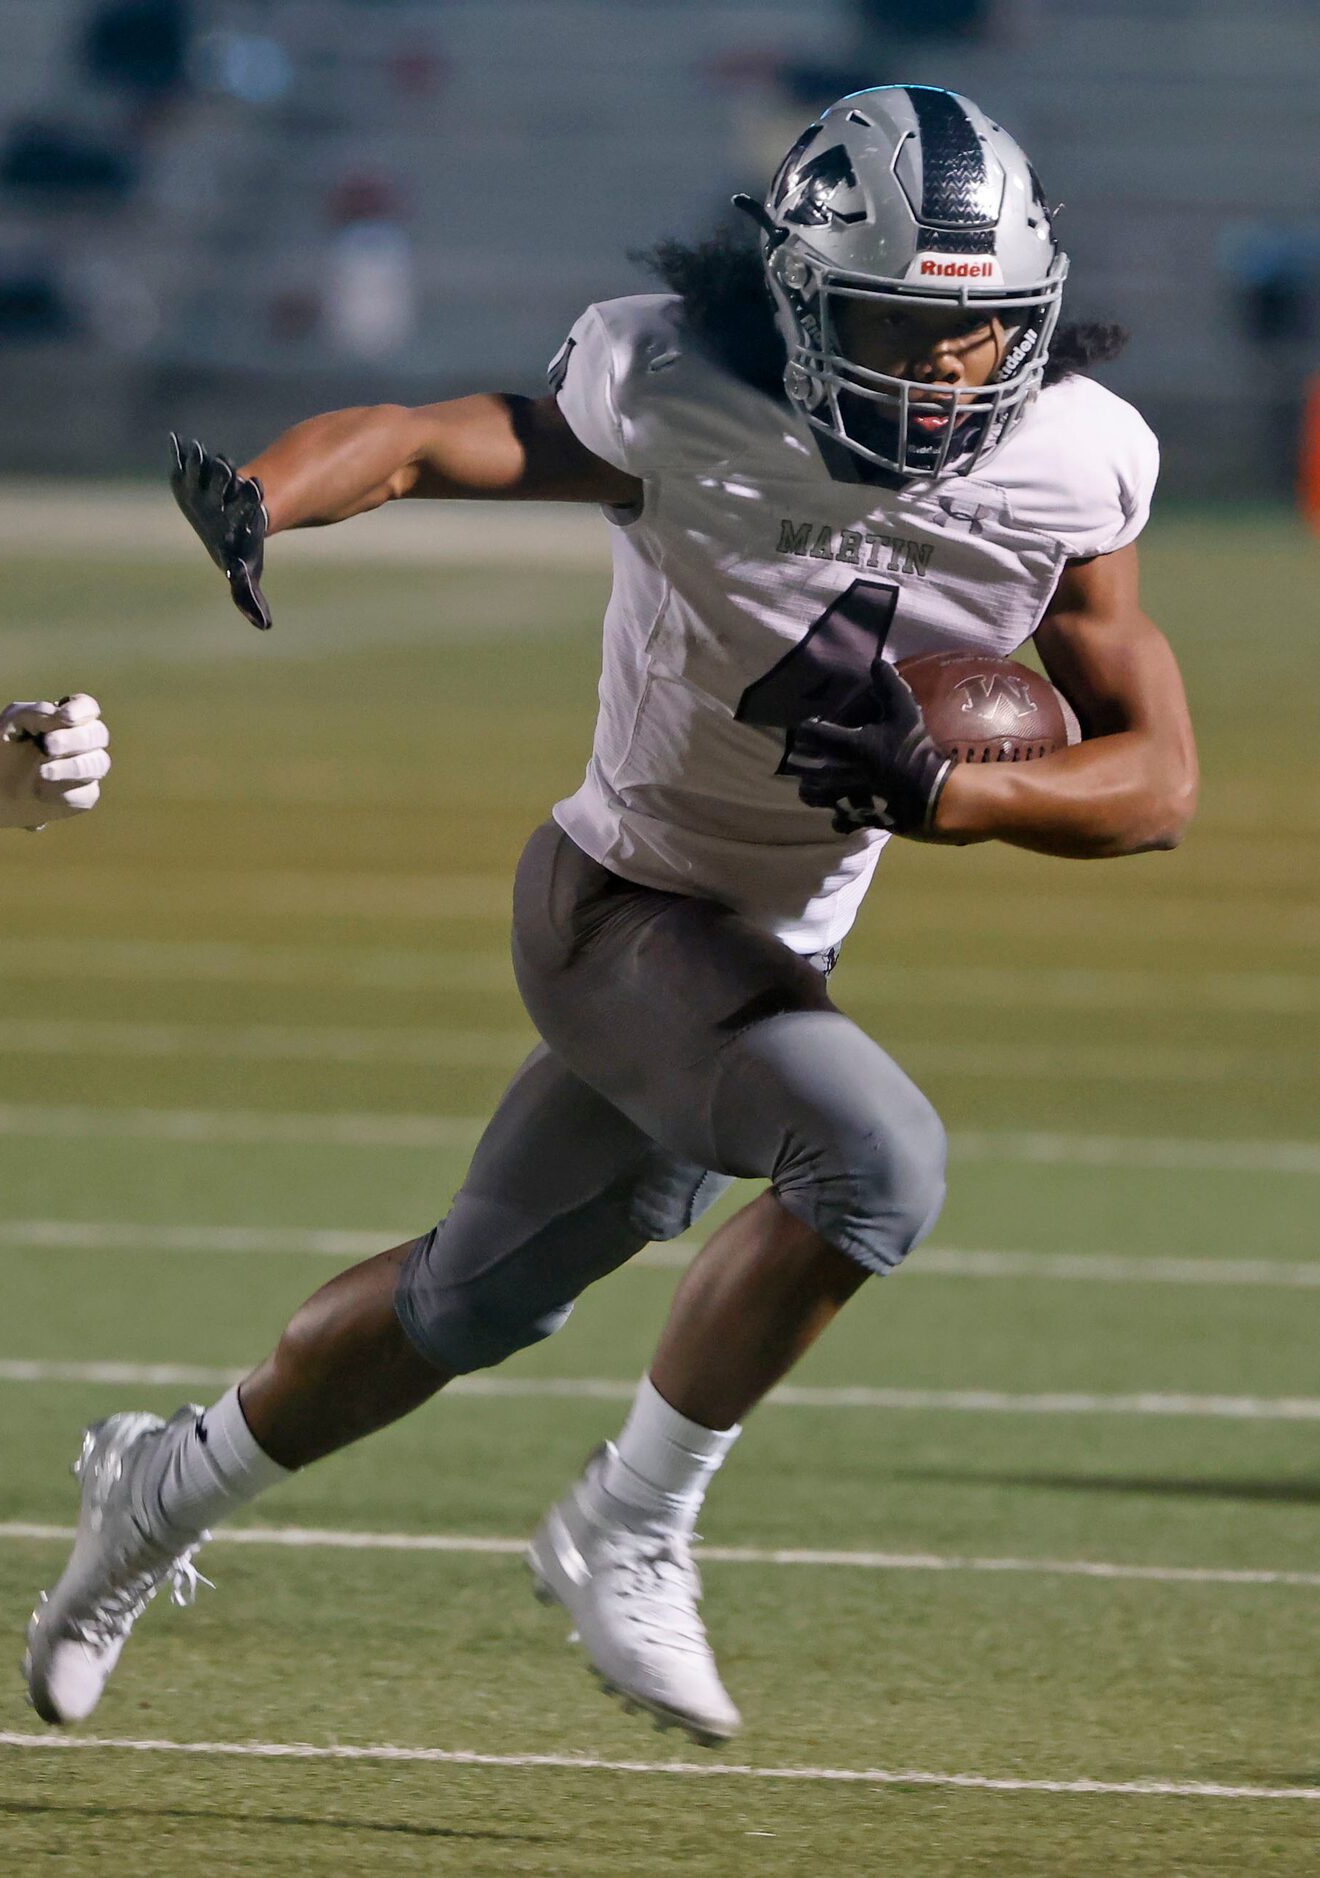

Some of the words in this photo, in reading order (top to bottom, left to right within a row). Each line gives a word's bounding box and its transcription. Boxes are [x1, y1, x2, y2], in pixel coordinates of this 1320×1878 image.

[920, 260, 993, 277] Riddell
[776, 519, 935, 577] MARTIN
[733, 577, 900, 776] 4
